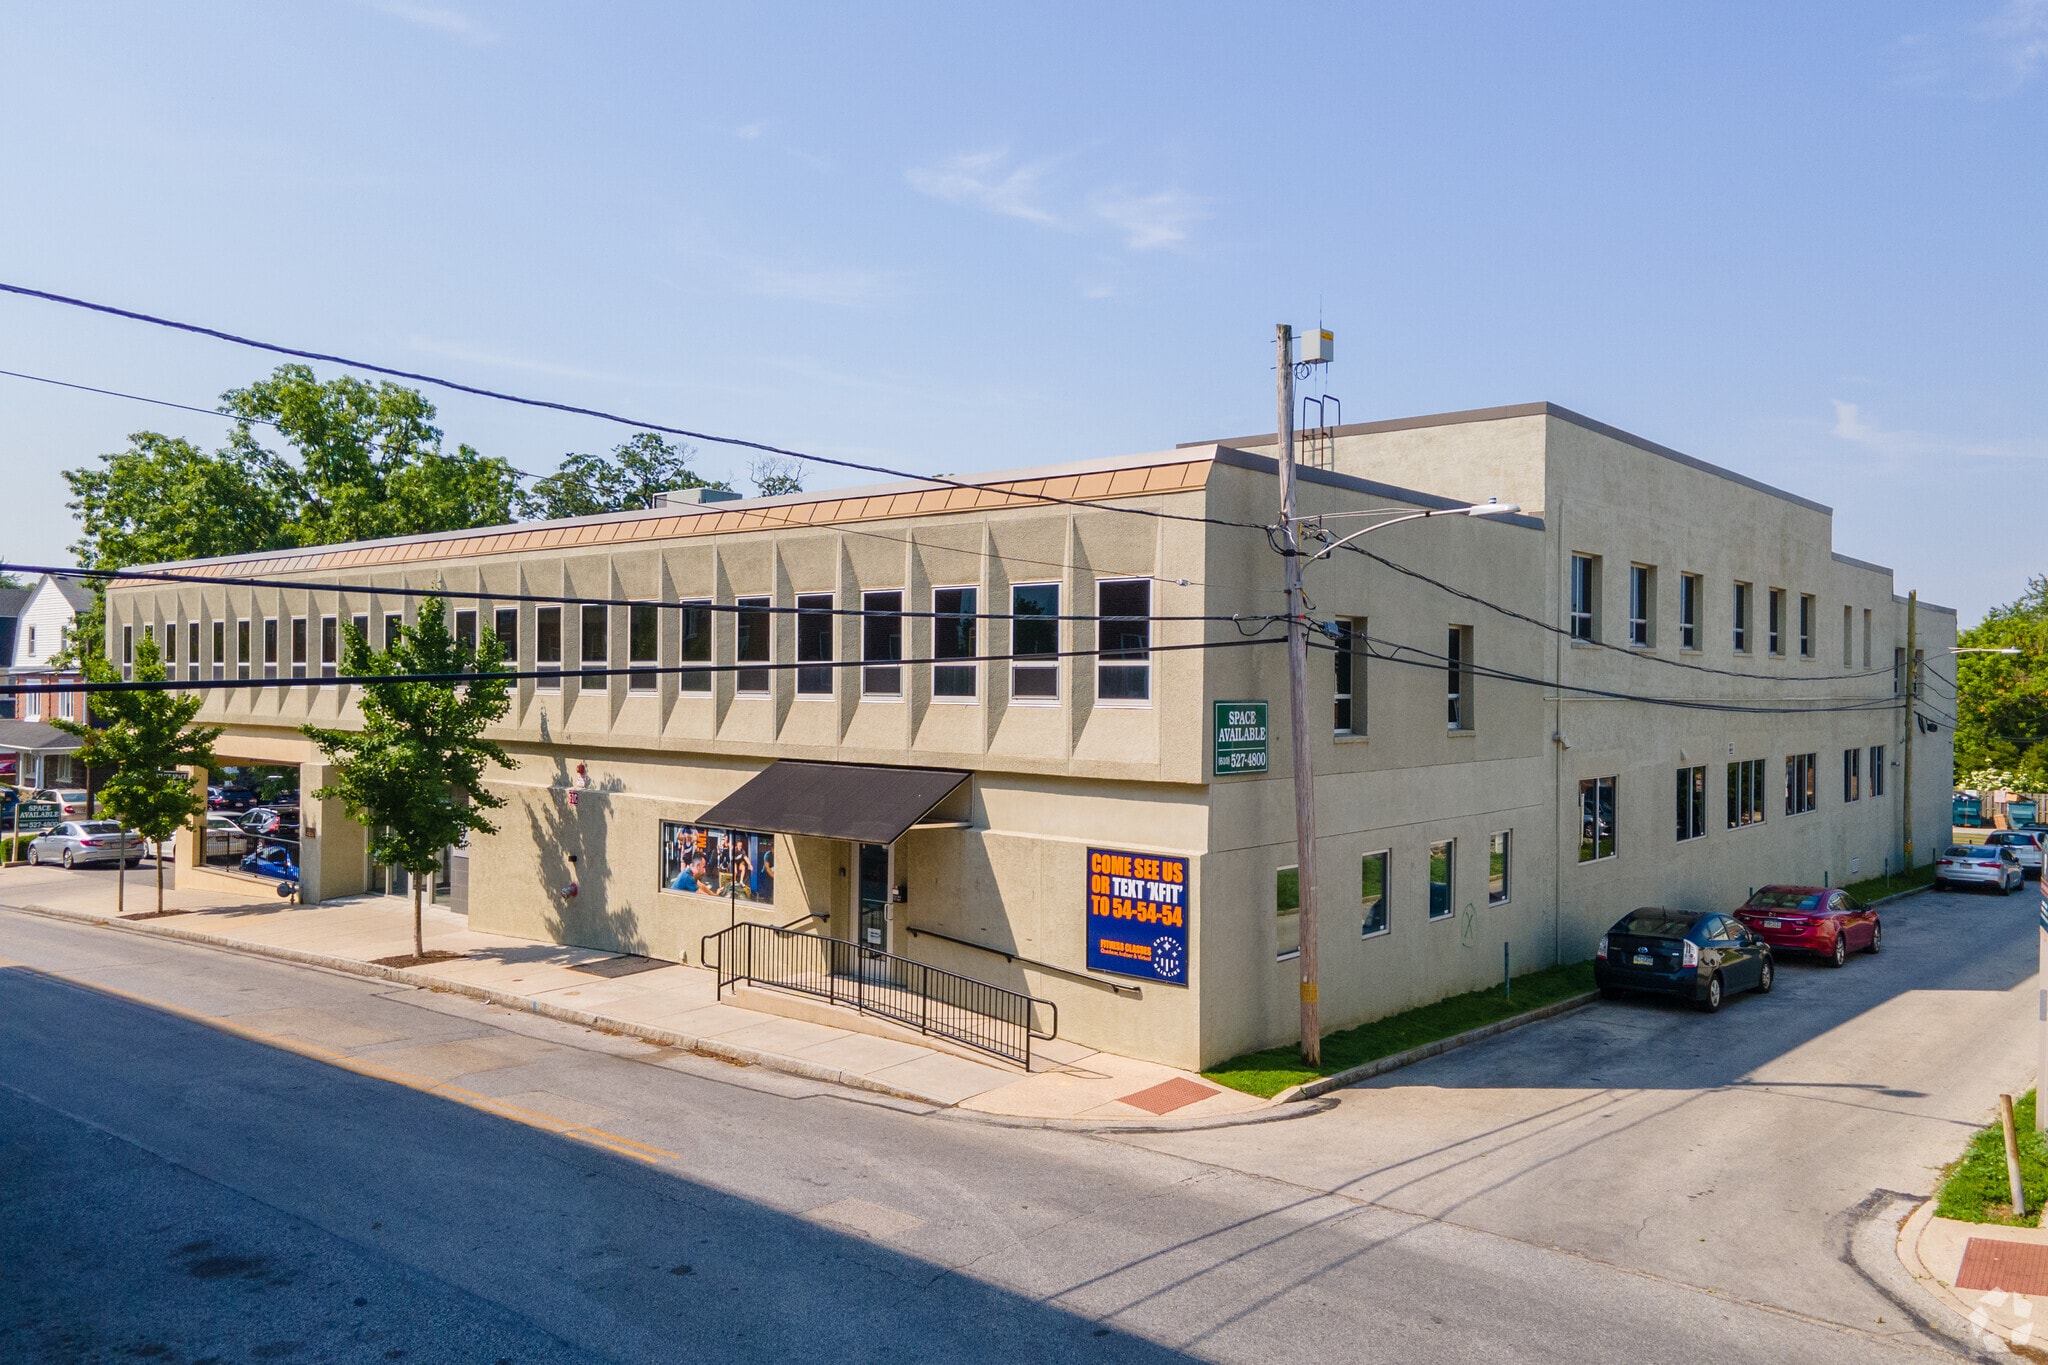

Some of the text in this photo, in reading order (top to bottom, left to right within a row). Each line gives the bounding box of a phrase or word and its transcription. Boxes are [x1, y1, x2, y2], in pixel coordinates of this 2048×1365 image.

[1229, 711, 1256, 725] SPACE
[1218, 727, 1266, 742] AVAILABLE
[1231, 752, 1266, 767] 527-4800
[1091, 853, 1183, 883] COME SEE US
[1091, 874, 1110, 895] OR
[1112, 876, 1145, 899] TEXT
[1091, 895, 1183, 927] TO 54-54-54
[1100, 938, 1152, 956] FITNESS CLASSES
